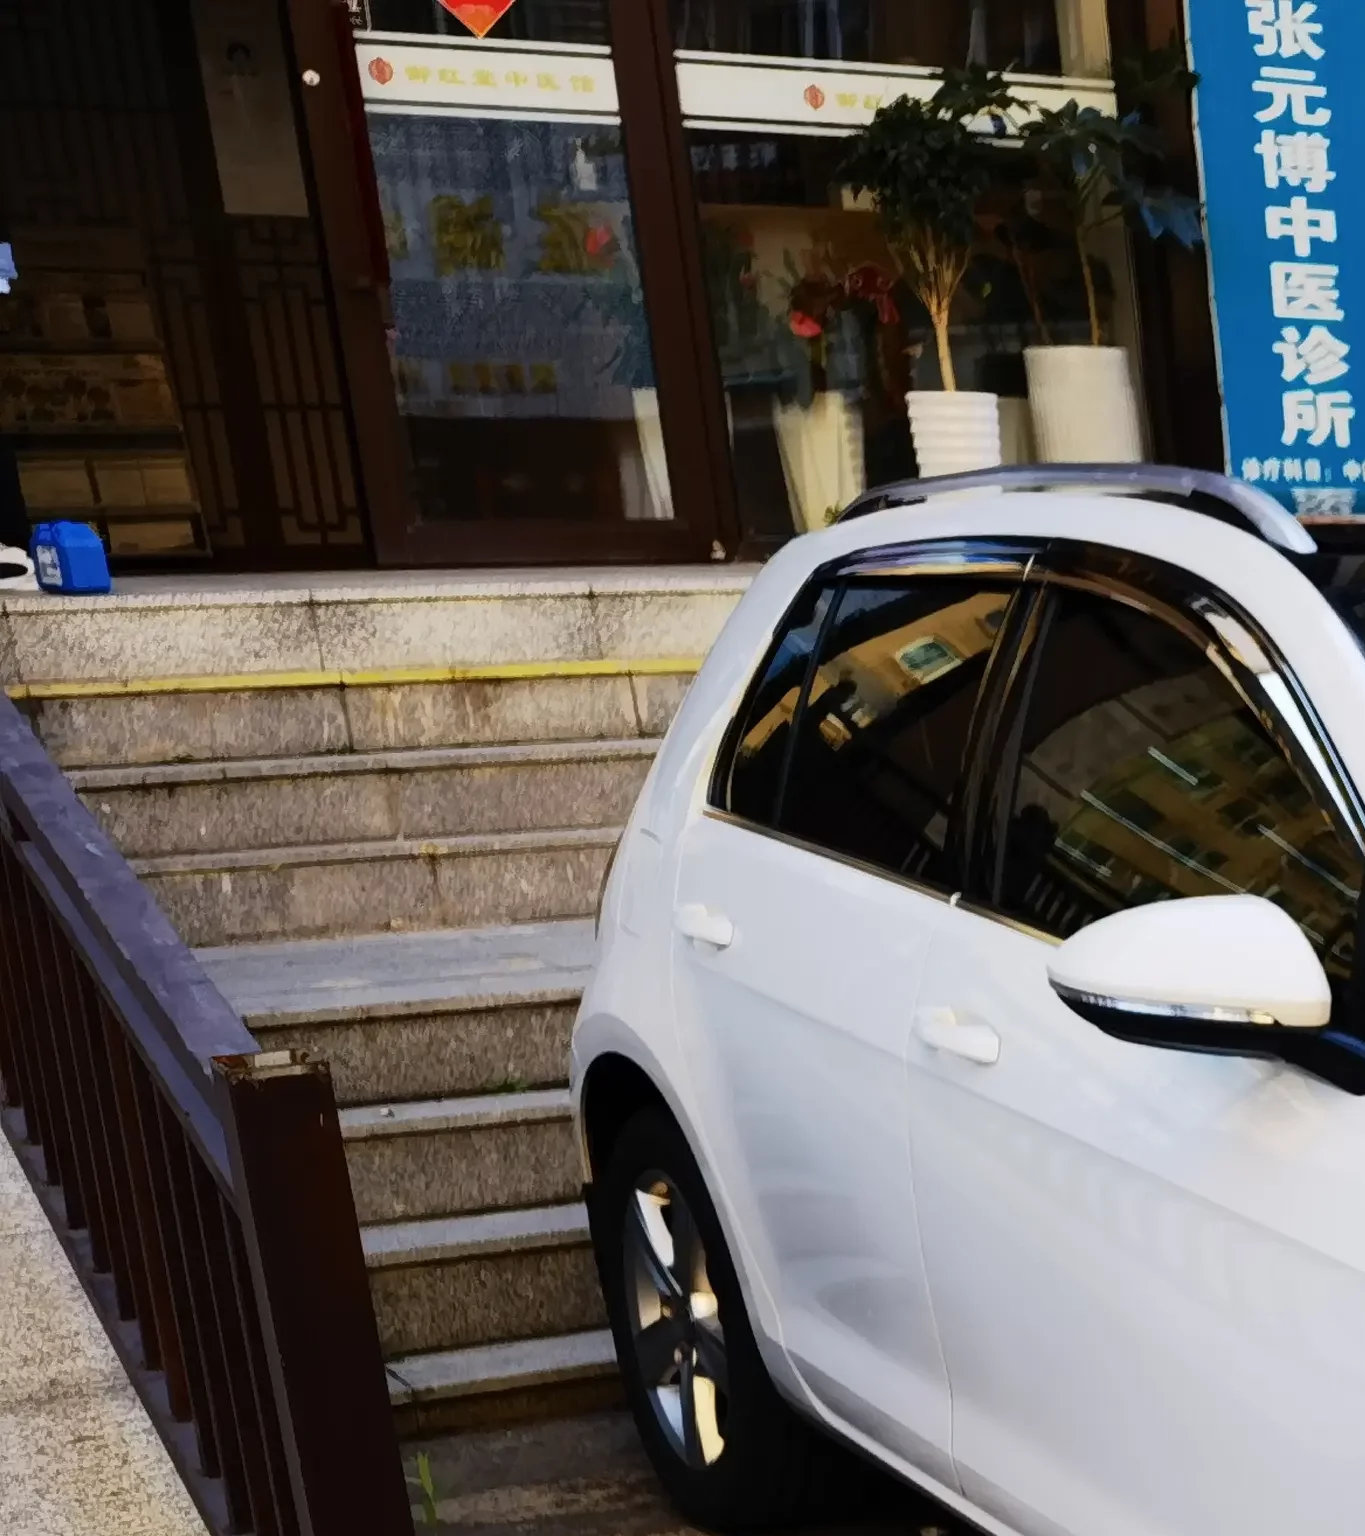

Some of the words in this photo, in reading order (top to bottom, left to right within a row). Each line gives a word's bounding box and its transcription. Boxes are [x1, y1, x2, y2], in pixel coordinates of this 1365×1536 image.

[1244, 0, 1356, 449] 张元博中医诊所
